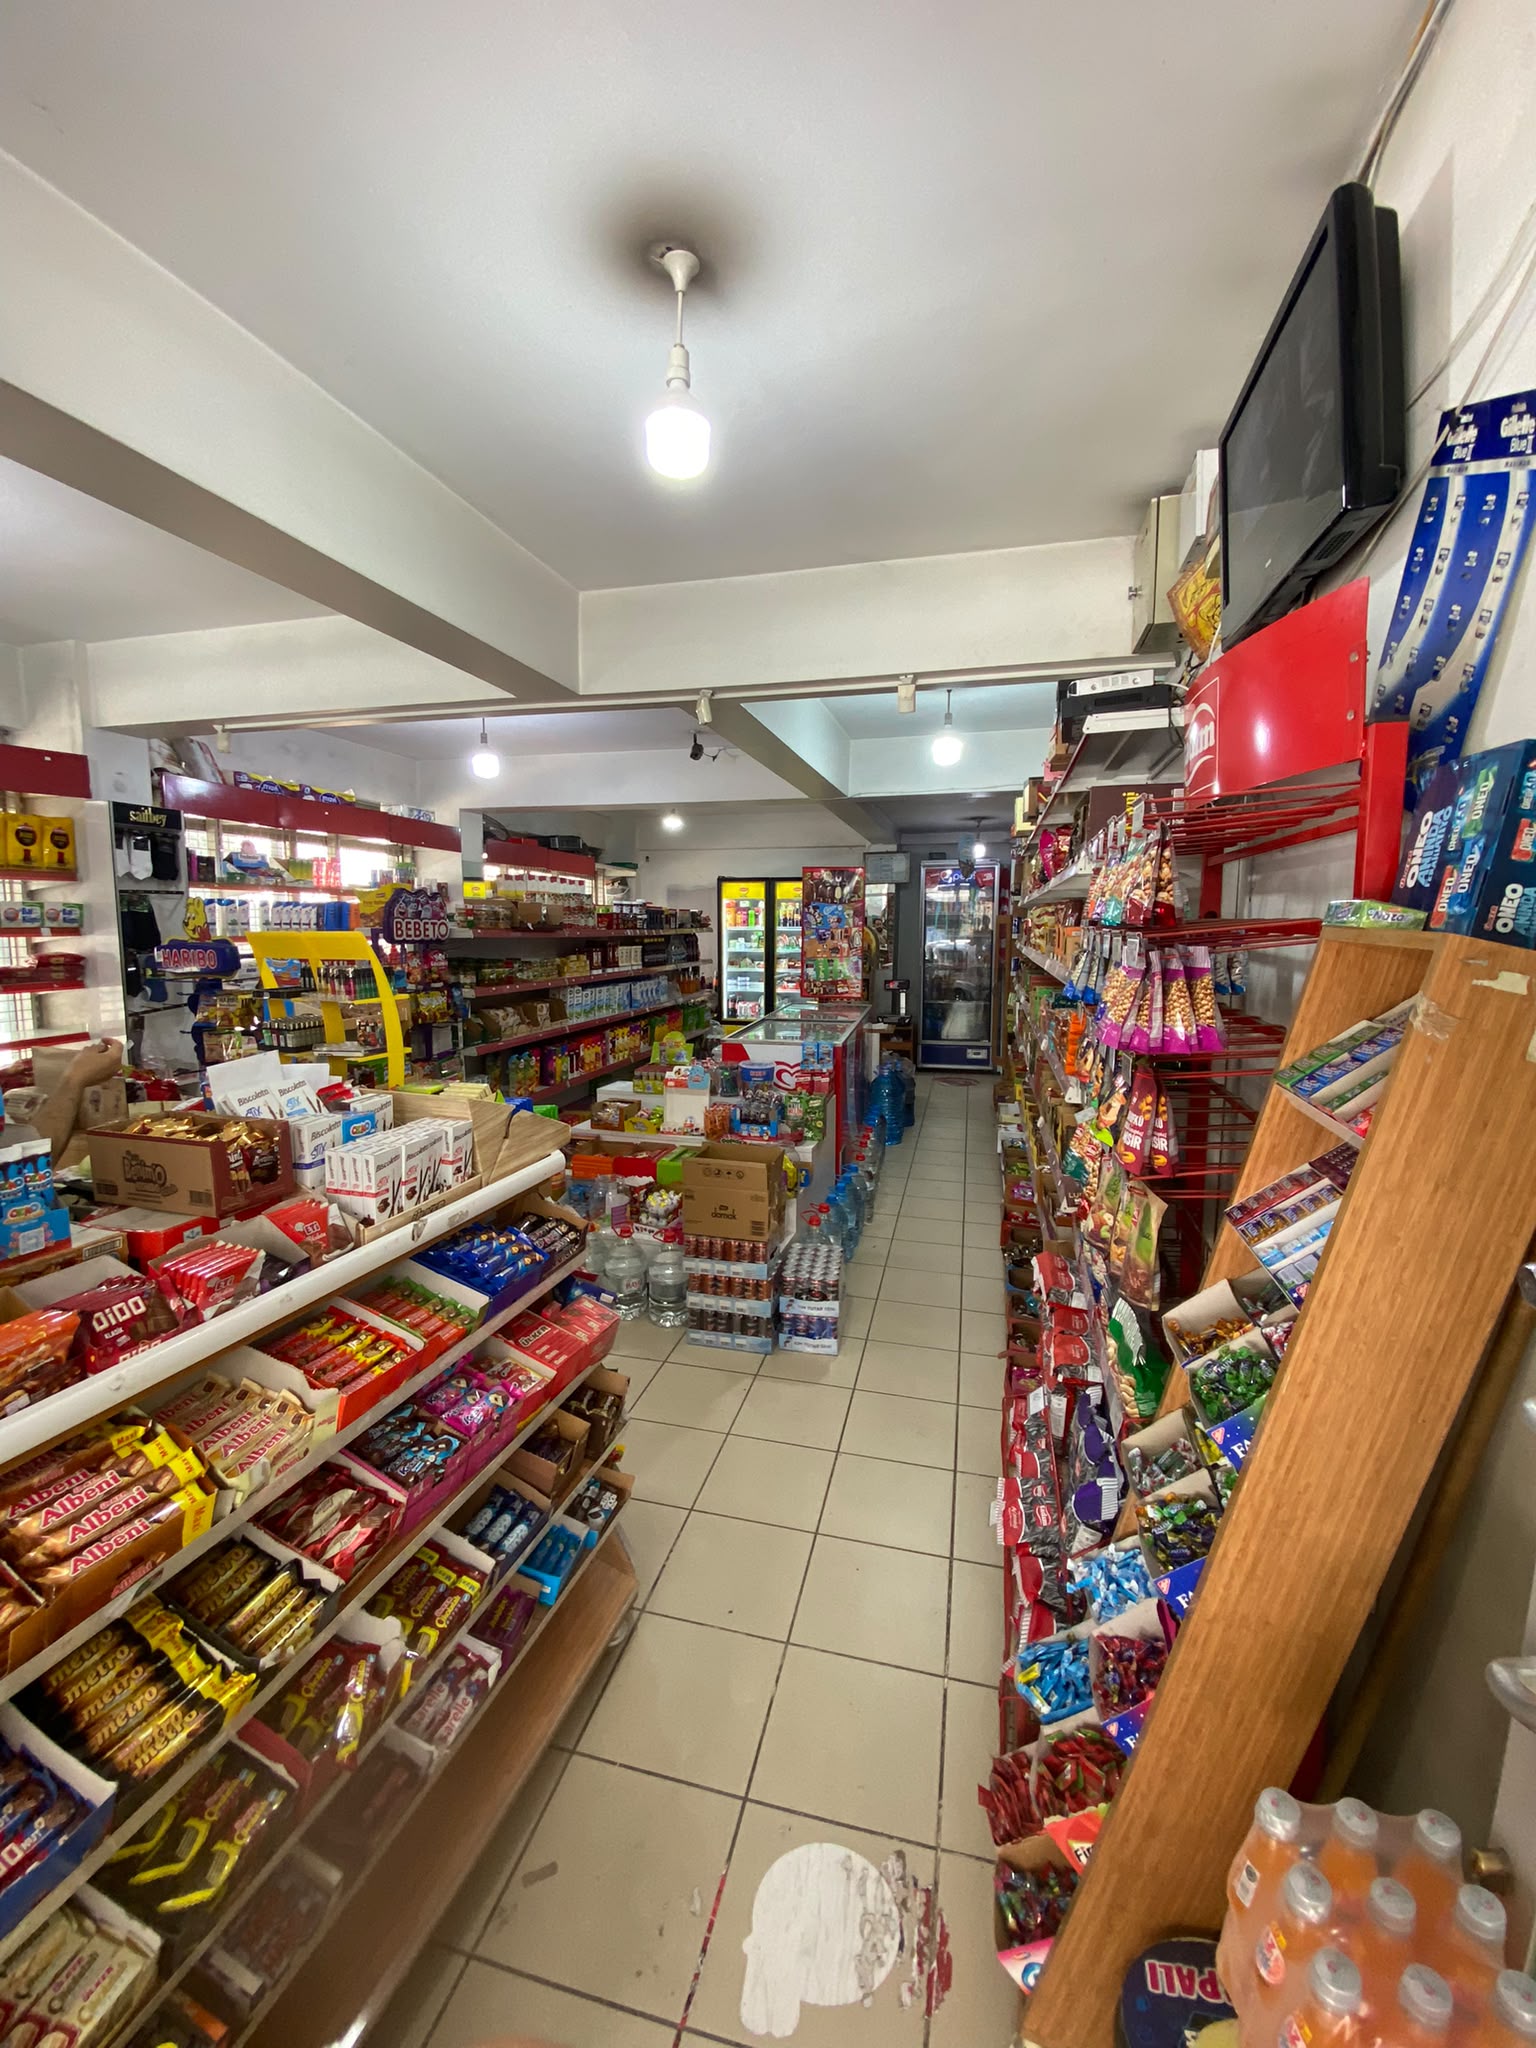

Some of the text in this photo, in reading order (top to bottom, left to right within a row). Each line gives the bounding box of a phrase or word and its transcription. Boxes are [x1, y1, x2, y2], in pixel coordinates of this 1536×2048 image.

[129, 807, 168, 827] saitbey
[1406, 810, 1434, 889] ONEO
[393, 918, 449, 941] BEBETO
[1495, 882, 1525, 934] ONEO
[161, 948, 218, 970] HARIBO
[201, 1411, 254, 1451] Albeni
[220, 1413, 273, 1460] Albeni
[237, 1427, 288, 1475] Albeni
[8, 1468, 93, 1519] Albeni
[40, 1469, 123, 1529] Albeni
[67, 1485, 149, 1545] Albeni
[70, 1517, 152, 1577] Albeni
[63, 1644, 130, 1706] metro
[78, 1664, 145, 1724] metro
[90, 1684, 159, 1749] metro
[1145, 1959, 1233, 2006] PALI
